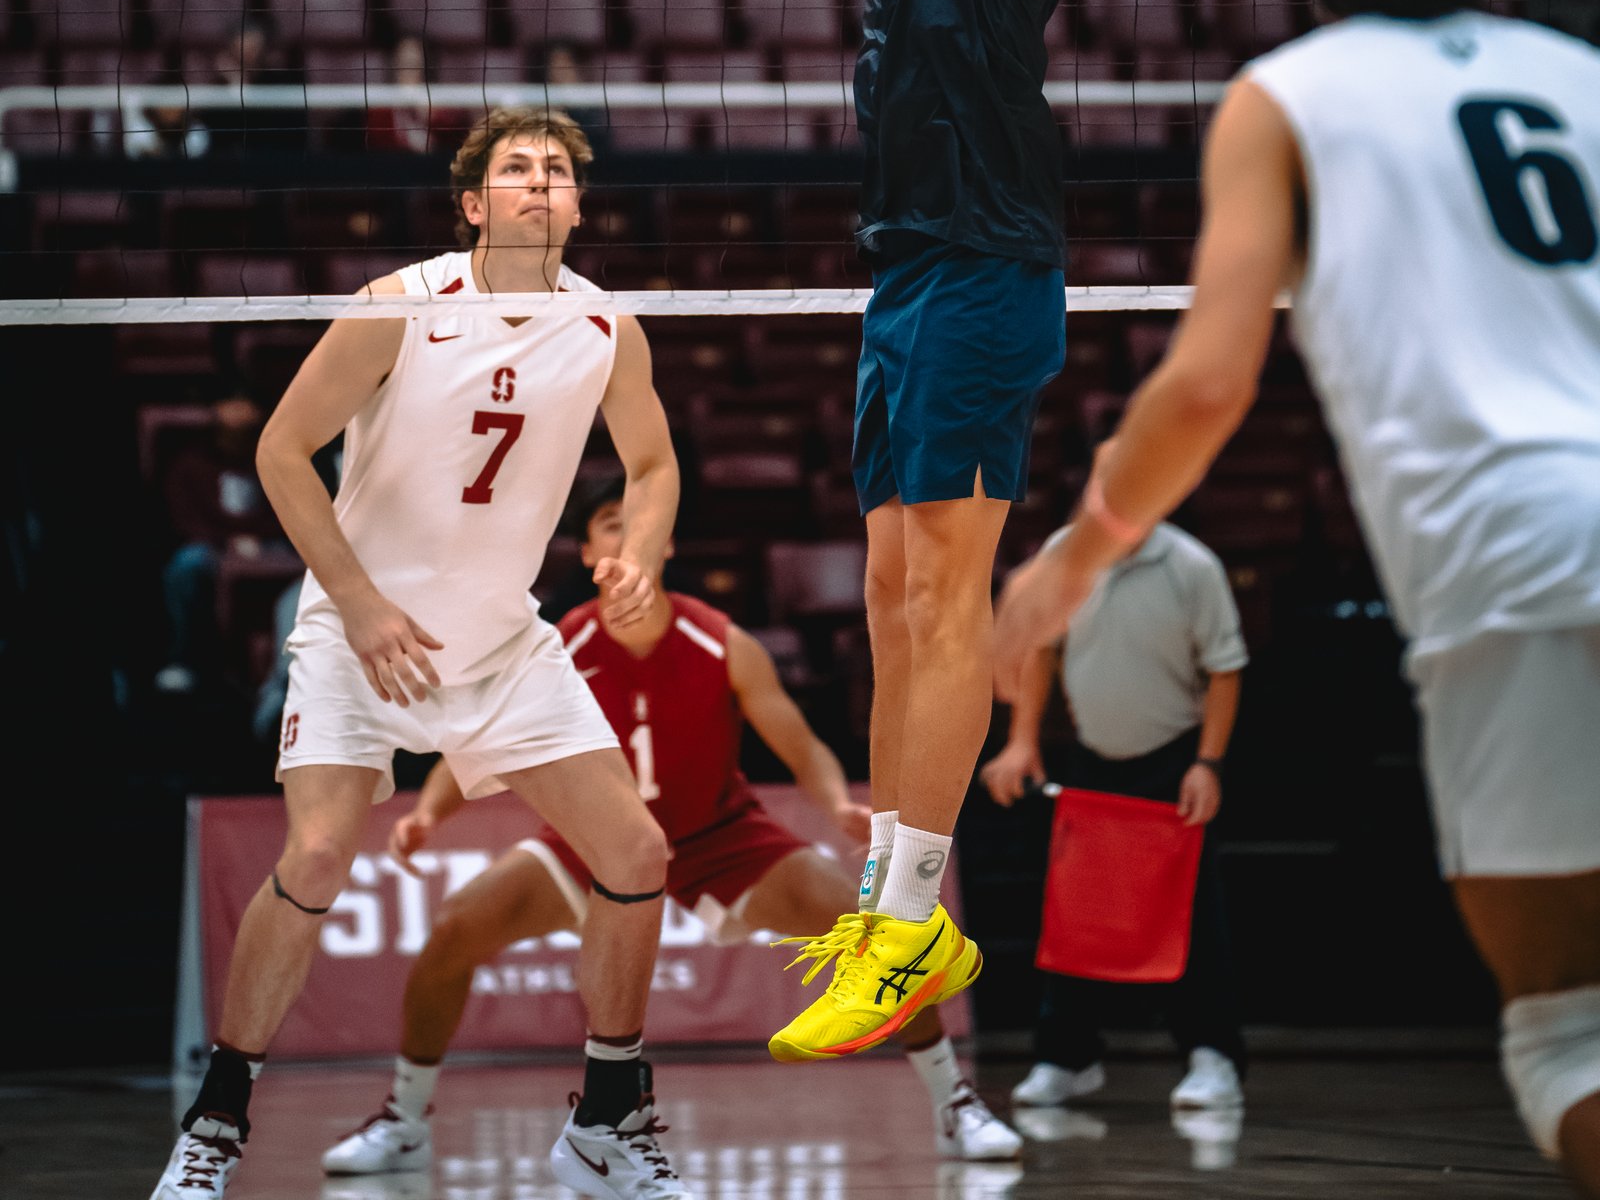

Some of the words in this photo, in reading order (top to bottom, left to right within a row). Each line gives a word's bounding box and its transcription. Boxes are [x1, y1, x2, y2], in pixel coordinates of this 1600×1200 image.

[1457, 97, 1598, 266] 6
[461, 410, 525, 504] 7
[628, 724, 660, 801] 1
